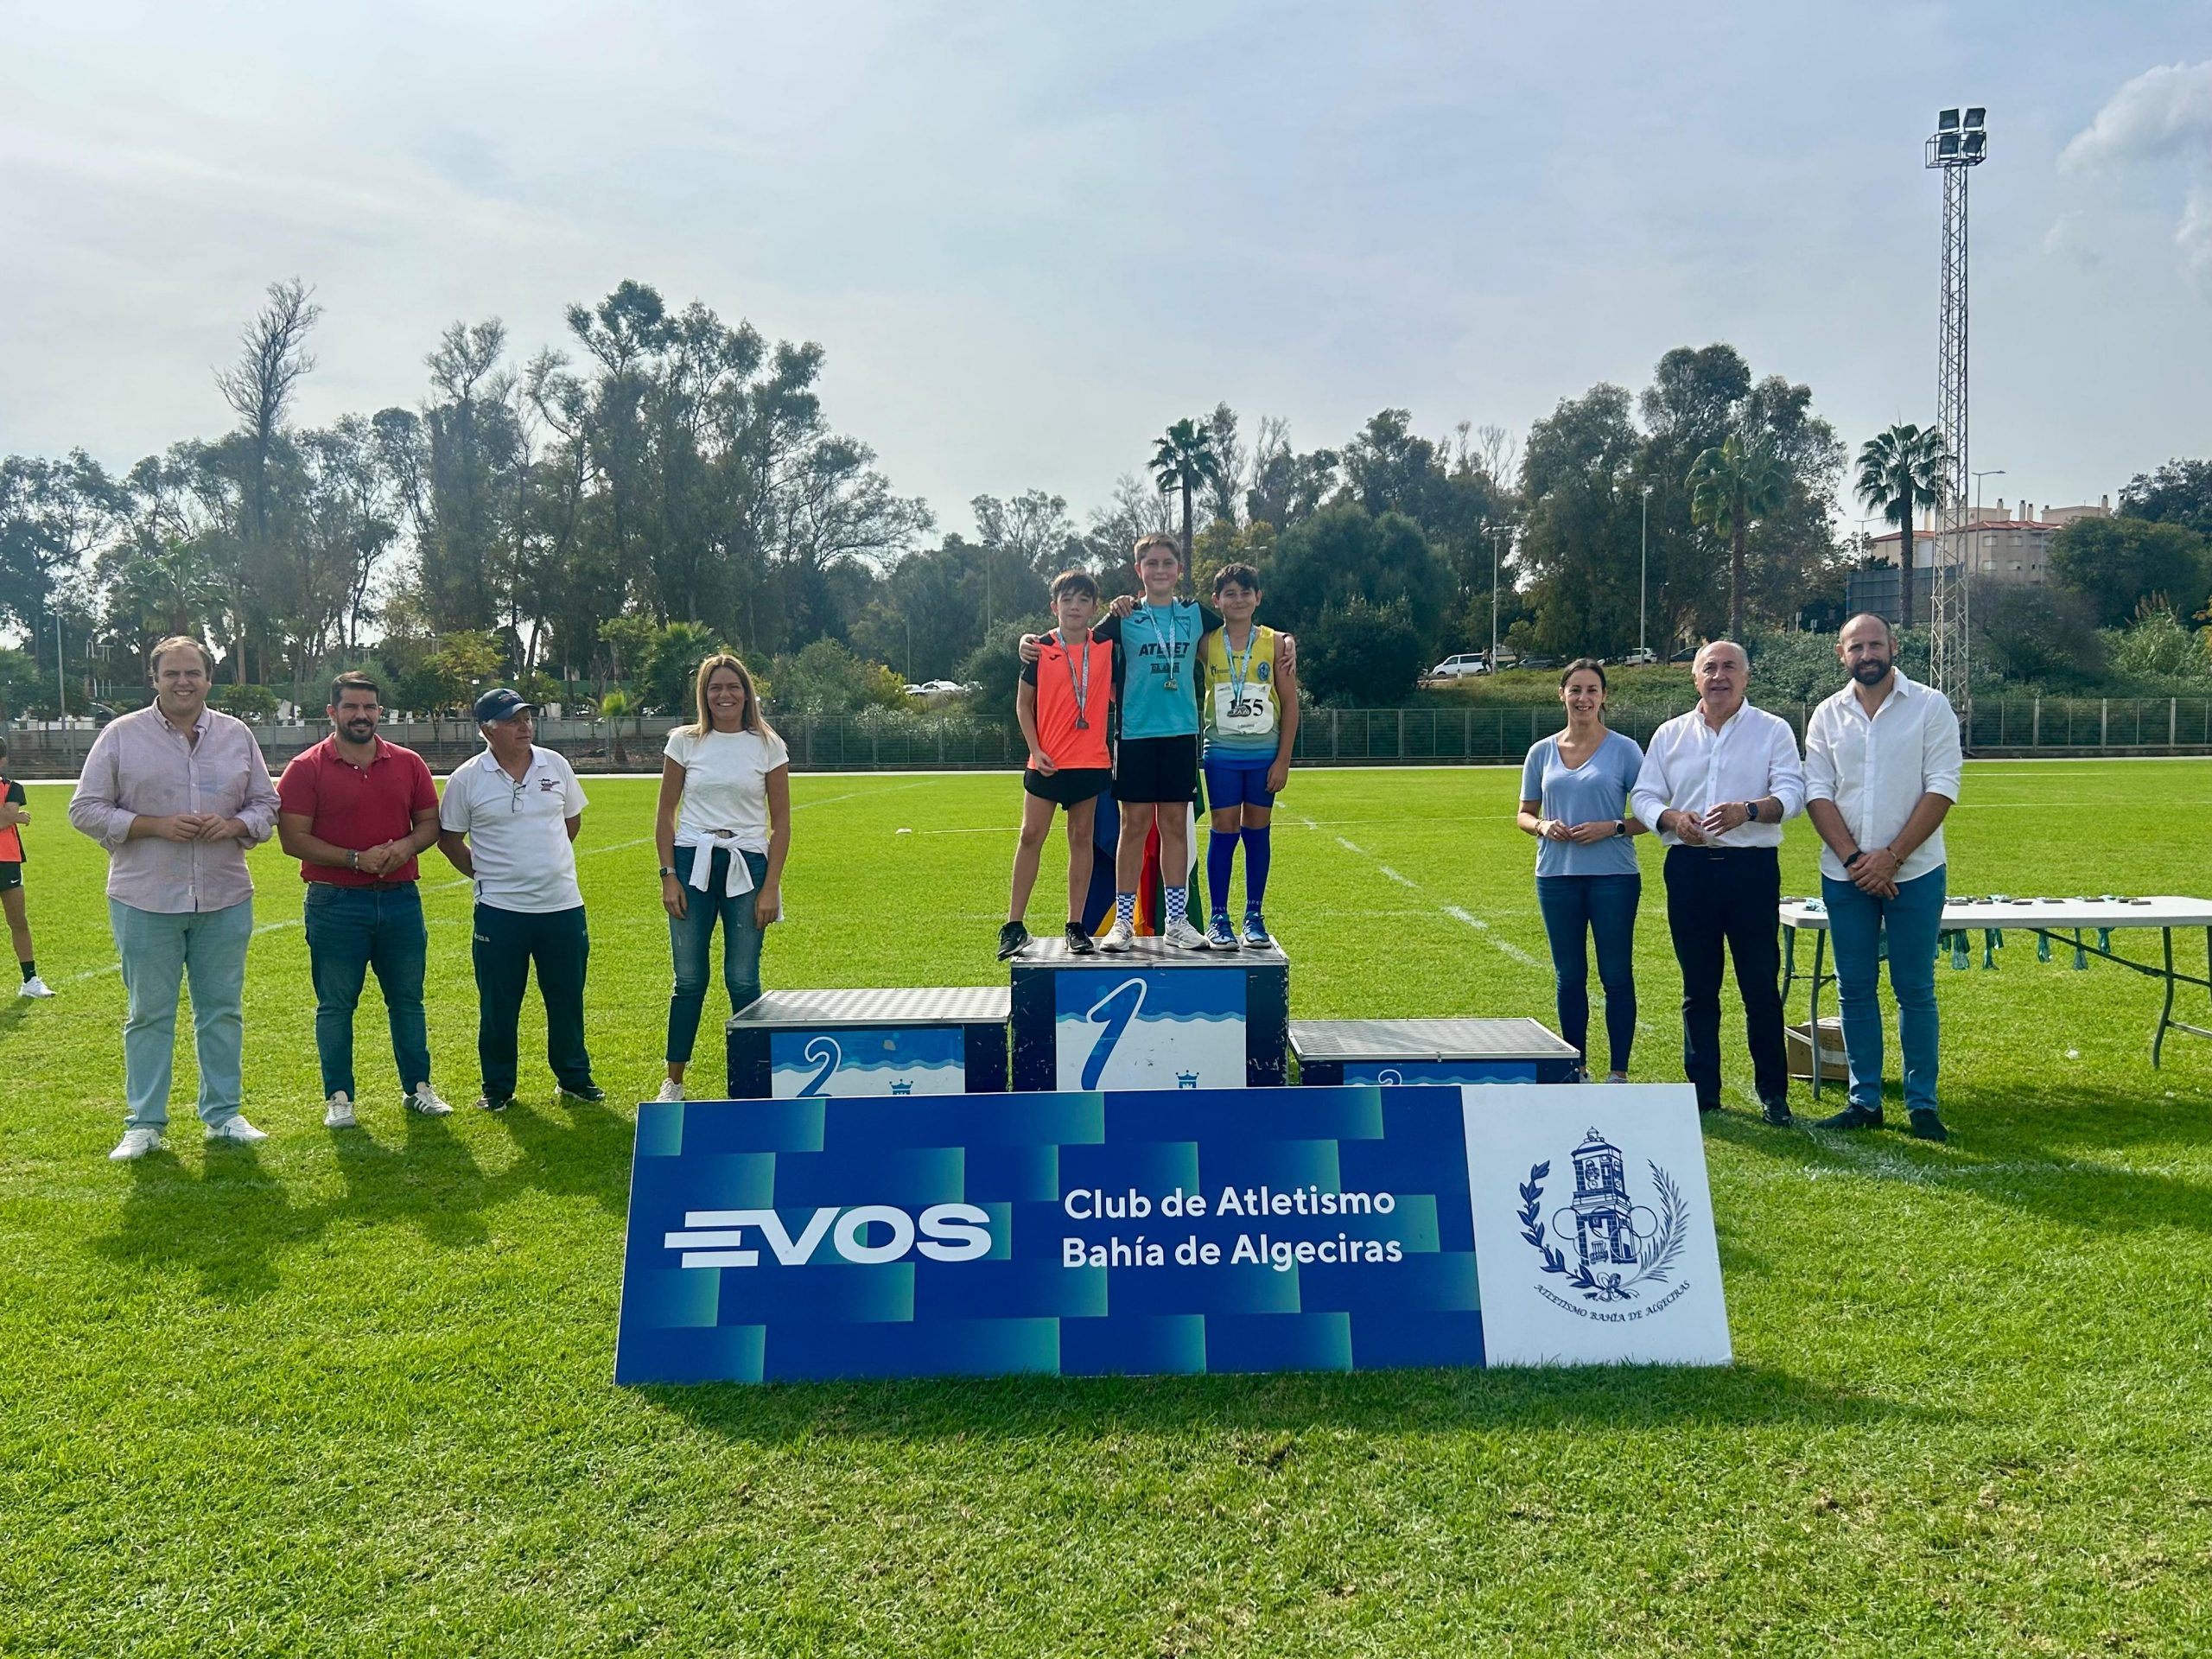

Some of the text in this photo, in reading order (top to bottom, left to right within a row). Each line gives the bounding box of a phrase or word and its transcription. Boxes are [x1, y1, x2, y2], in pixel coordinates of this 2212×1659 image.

[1080, 977, 1147, 1090] 1
[796, 1036, 842, 1097] 2
[1064, 1185, 1395, 1219] Club de Atletismo
[664, 1202, 992, 1268] EVOS
[1062, 1232, 1402, 1272] Bahía de Algeciras
[1534, 1283, 1587, 1318] ATLETISMO
[1628, 1309, 1643, 1322] DE
[1645, 1280, 1691, 1318] ALGECIRAS
